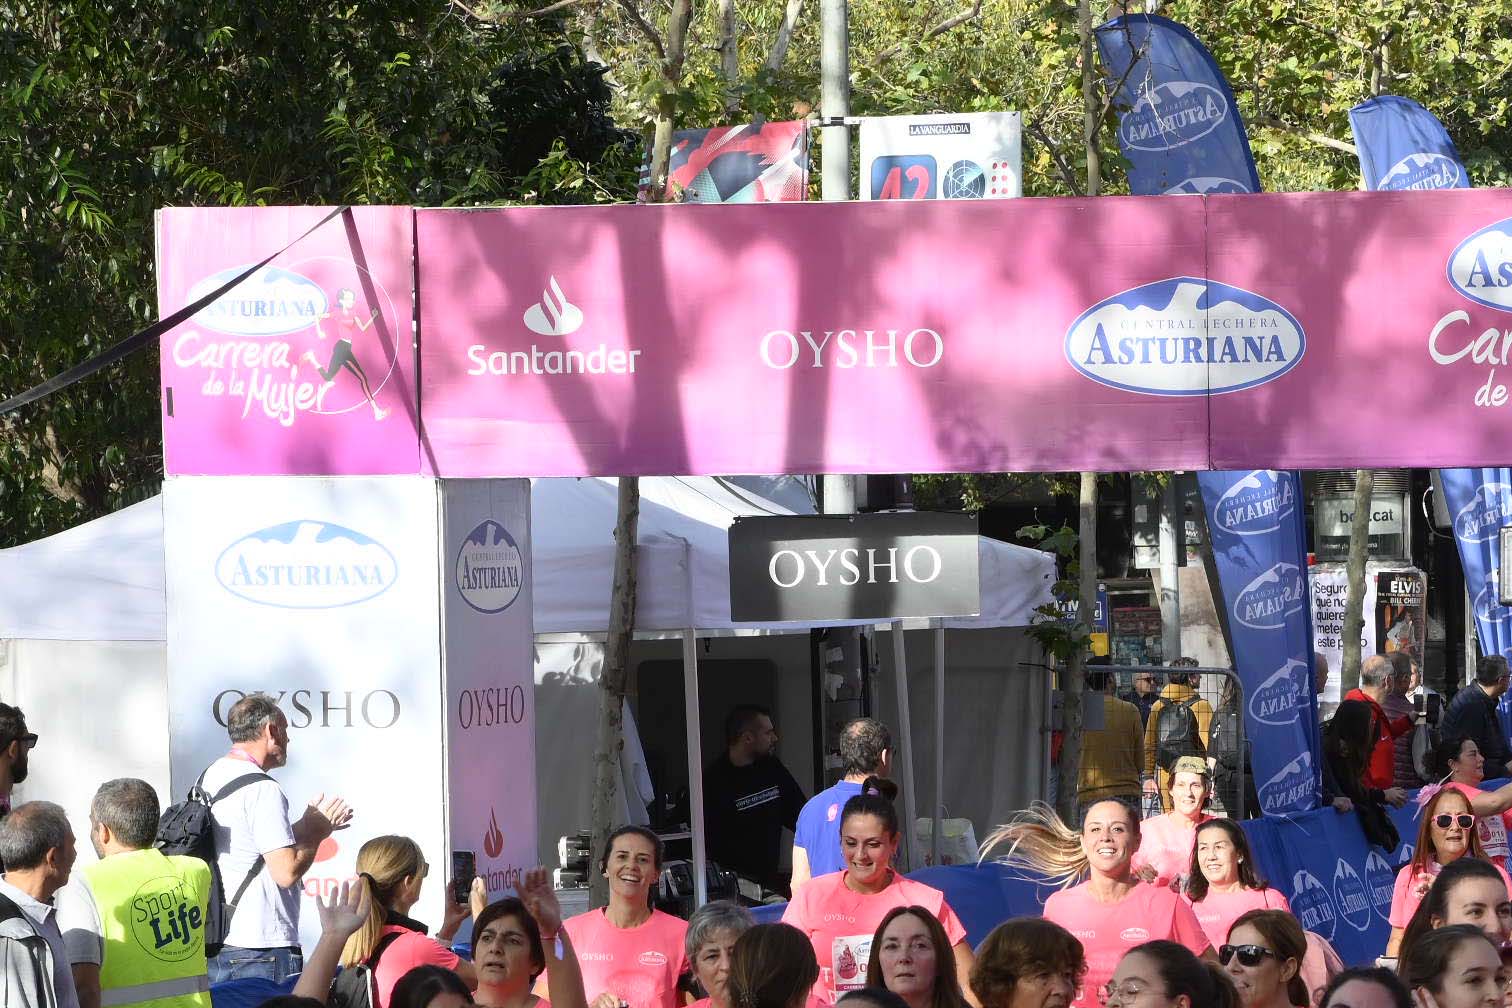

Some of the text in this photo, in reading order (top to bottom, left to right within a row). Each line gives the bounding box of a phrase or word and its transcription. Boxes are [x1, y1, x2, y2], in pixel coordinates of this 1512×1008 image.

[1083, 321, 1288, 365] ASTURIANA
[1120, 317, 1279, 330] CENTRAL LECHERA
[172, 330, 293, 370] Carrera
[467, 343, 641, 377] Santander
[759, 328, 944, 368] OYSHO
[201, 366, 336, 427] de la Mujer
[1474, 367, 1509, 408] de
[231, 552, 386, 588] ASTURIANA
[461, 556, 520, 591] ASTURIANA
[768, 545, 943, 588] OYSHO
[1315, 599, 1331, 609] que
[1390, 581, 1422, 594] ELVIS
[1317, 638, 1336, 648] este
[212, 688, 402, 729] OSHO
[458, 685, 525, 730] OYSHO
[133, 880, 188, 923] Sport
[149, 902, 203, 949] Life
